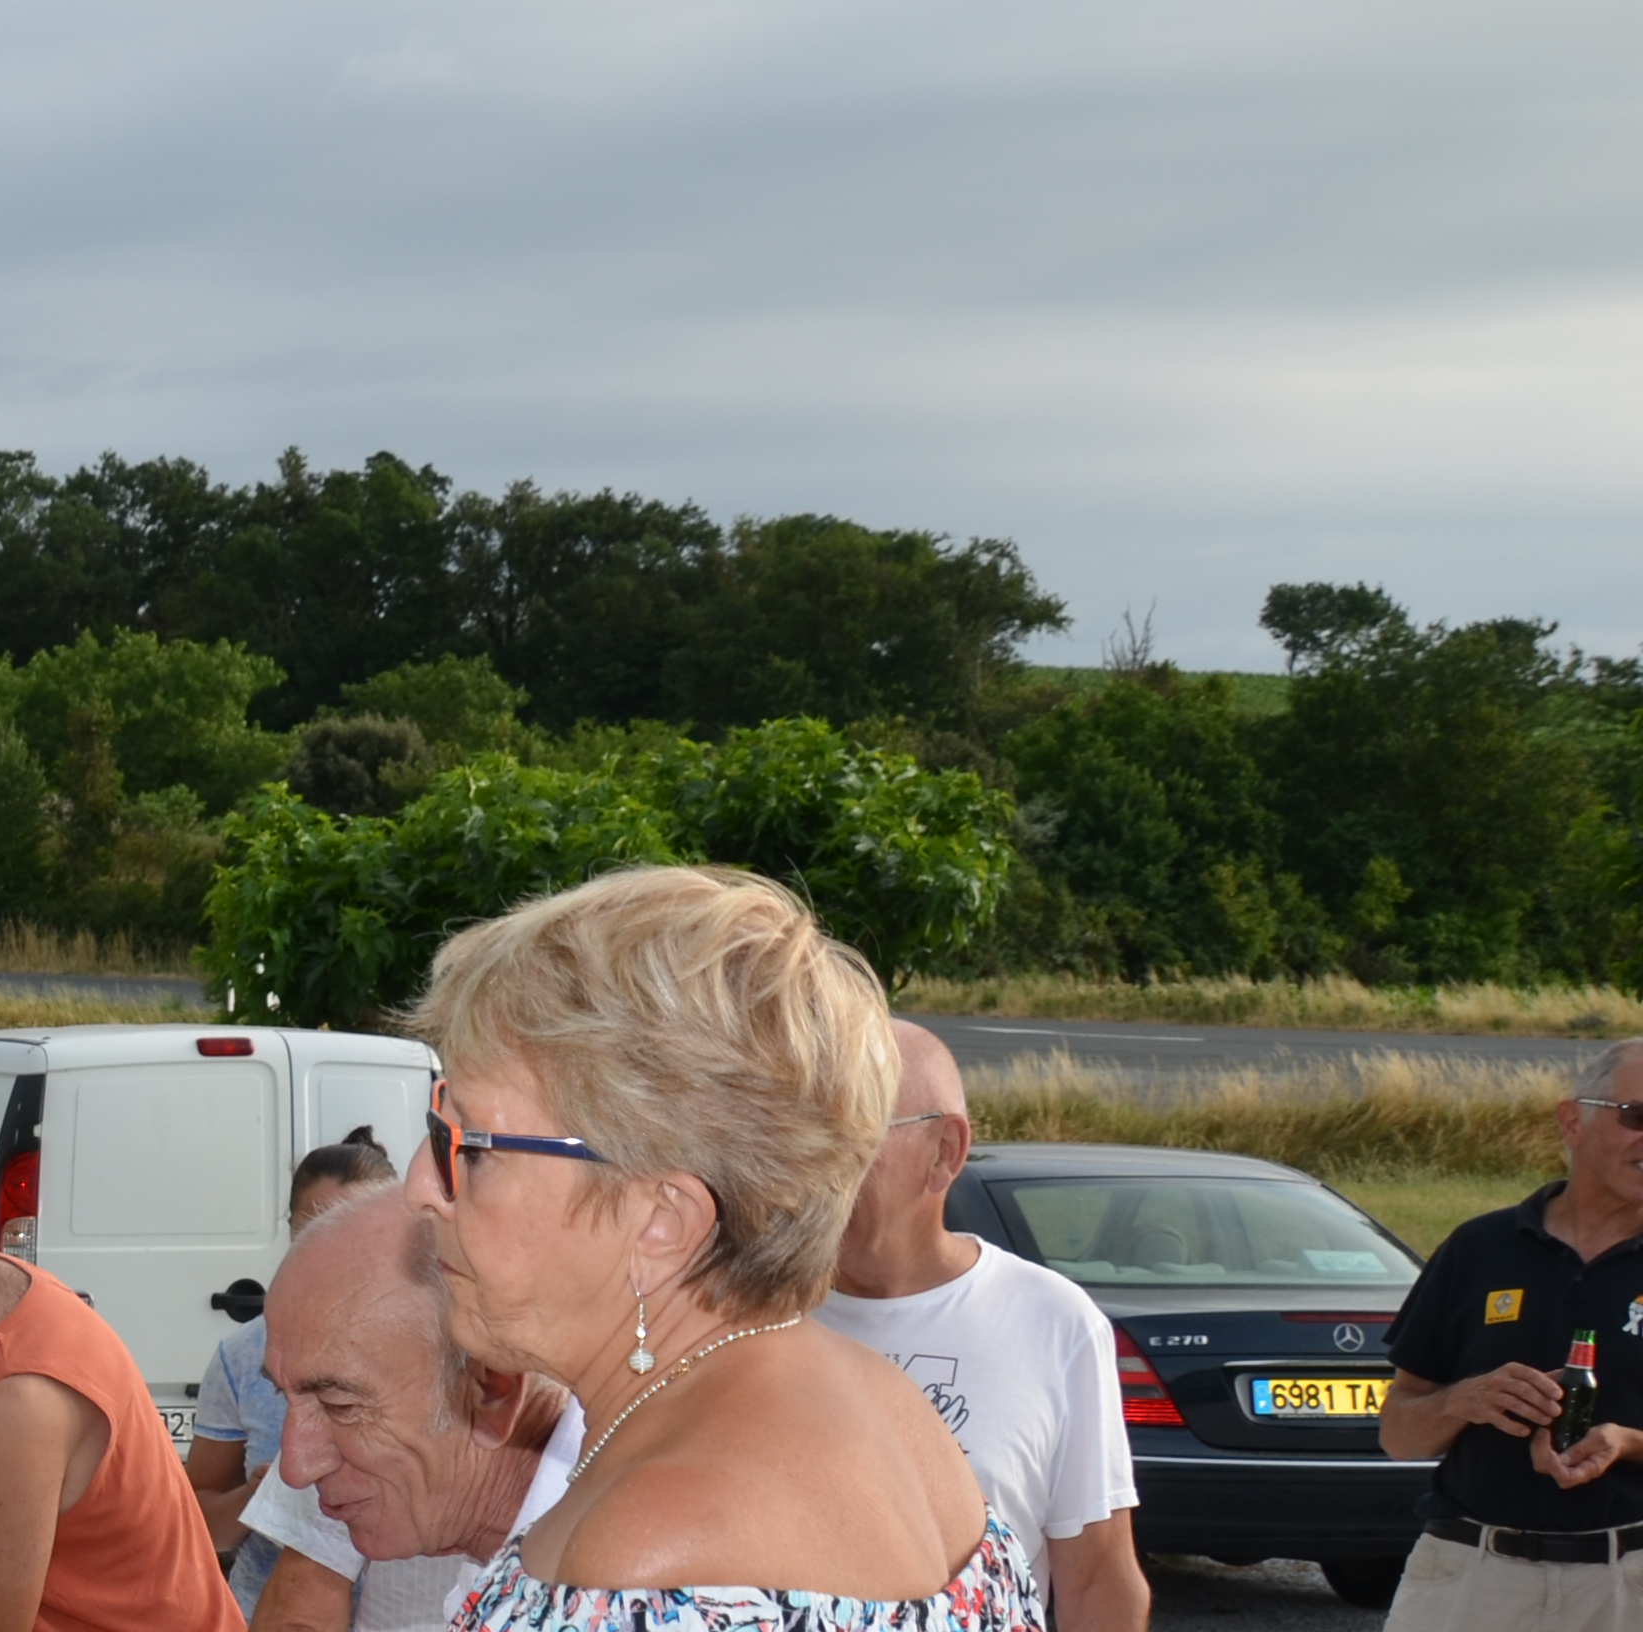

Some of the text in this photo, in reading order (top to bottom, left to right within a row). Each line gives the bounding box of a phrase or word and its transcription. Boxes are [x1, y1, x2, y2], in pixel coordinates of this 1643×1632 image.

[1166, 1335, 1209, 1346] 270
[1272, 1383, 1380, 1411] 6981 TA
